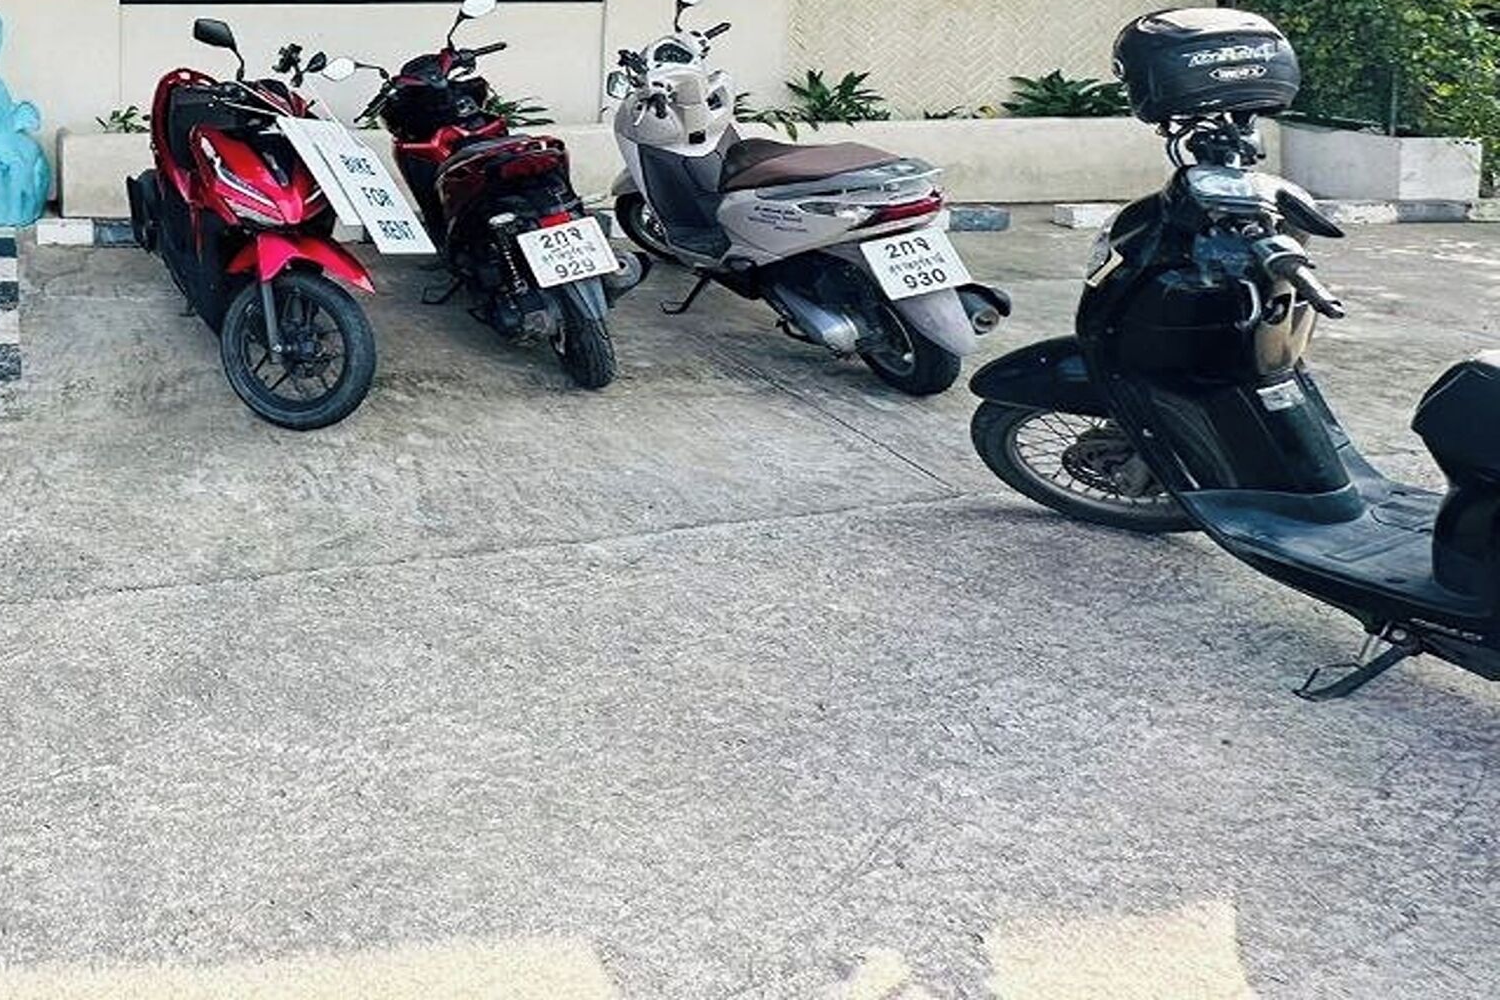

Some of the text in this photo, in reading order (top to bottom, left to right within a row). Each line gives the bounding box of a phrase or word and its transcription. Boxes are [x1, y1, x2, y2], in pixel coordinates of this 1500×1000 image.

[340, 154, 376, 176] BIKE
[361, 186, 395, 208] FOR
[377, 220, 416, 240] RENT
[884, 236, 931, 259] 2กจ
[554, 258, 597, 279] 929
[902, 268, 948, 289] 930
